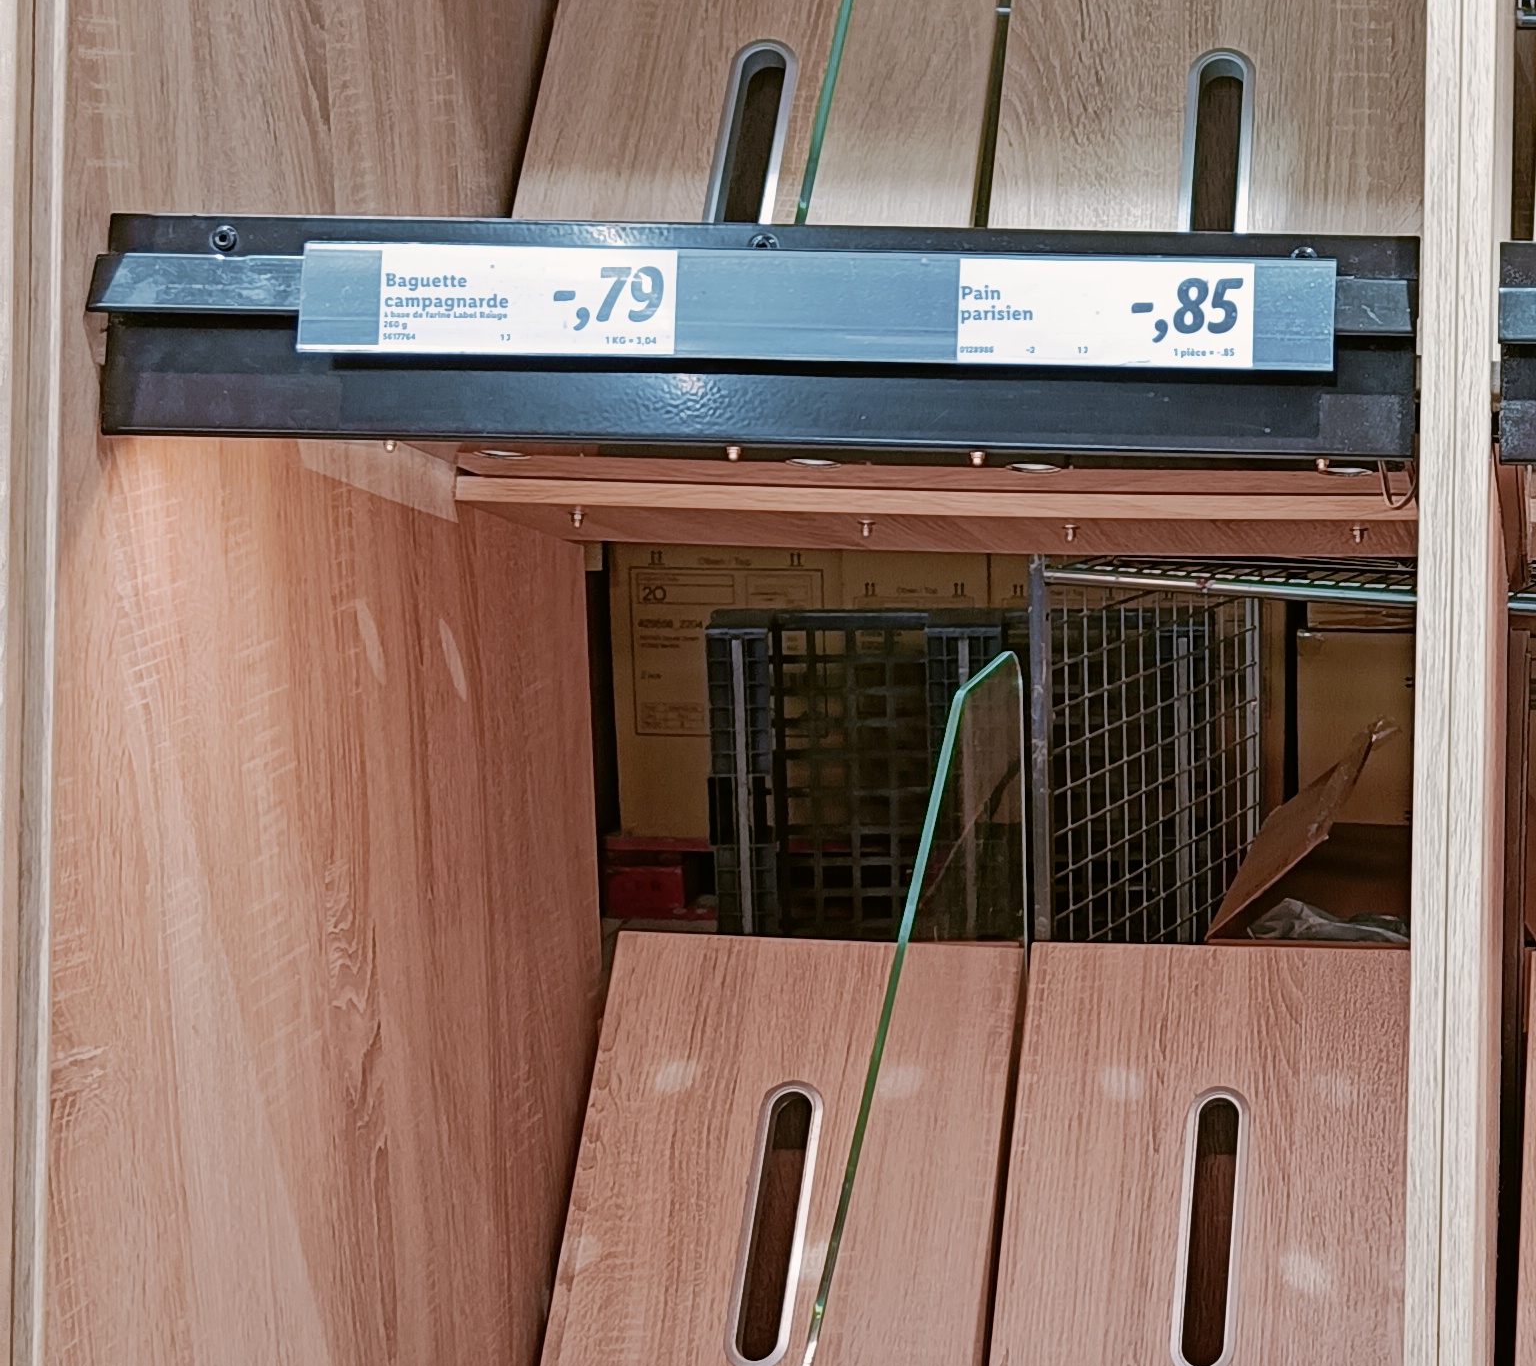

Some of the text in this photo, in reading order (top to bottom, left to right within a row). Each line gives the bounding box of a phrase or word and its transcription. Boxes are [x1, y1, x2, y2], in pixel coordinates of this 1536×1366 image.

[385, 272, 467, 291] Baguette
[960, 284, 1001, 301] Pain
[384, 293, 509, 312] campagnarde
[1131, 277, 1244, 343] -,85
[479, 311, 508, 320] Rouge
[960, 304, 1034, 325] parisien
[402, 322, 408, 330] g
[612, 336, 627, 344] KG
[636, 336, 657, 346] 3,04
[1181, 348, 1207, 358] pièce
[641, 585, 668, 603] 20
